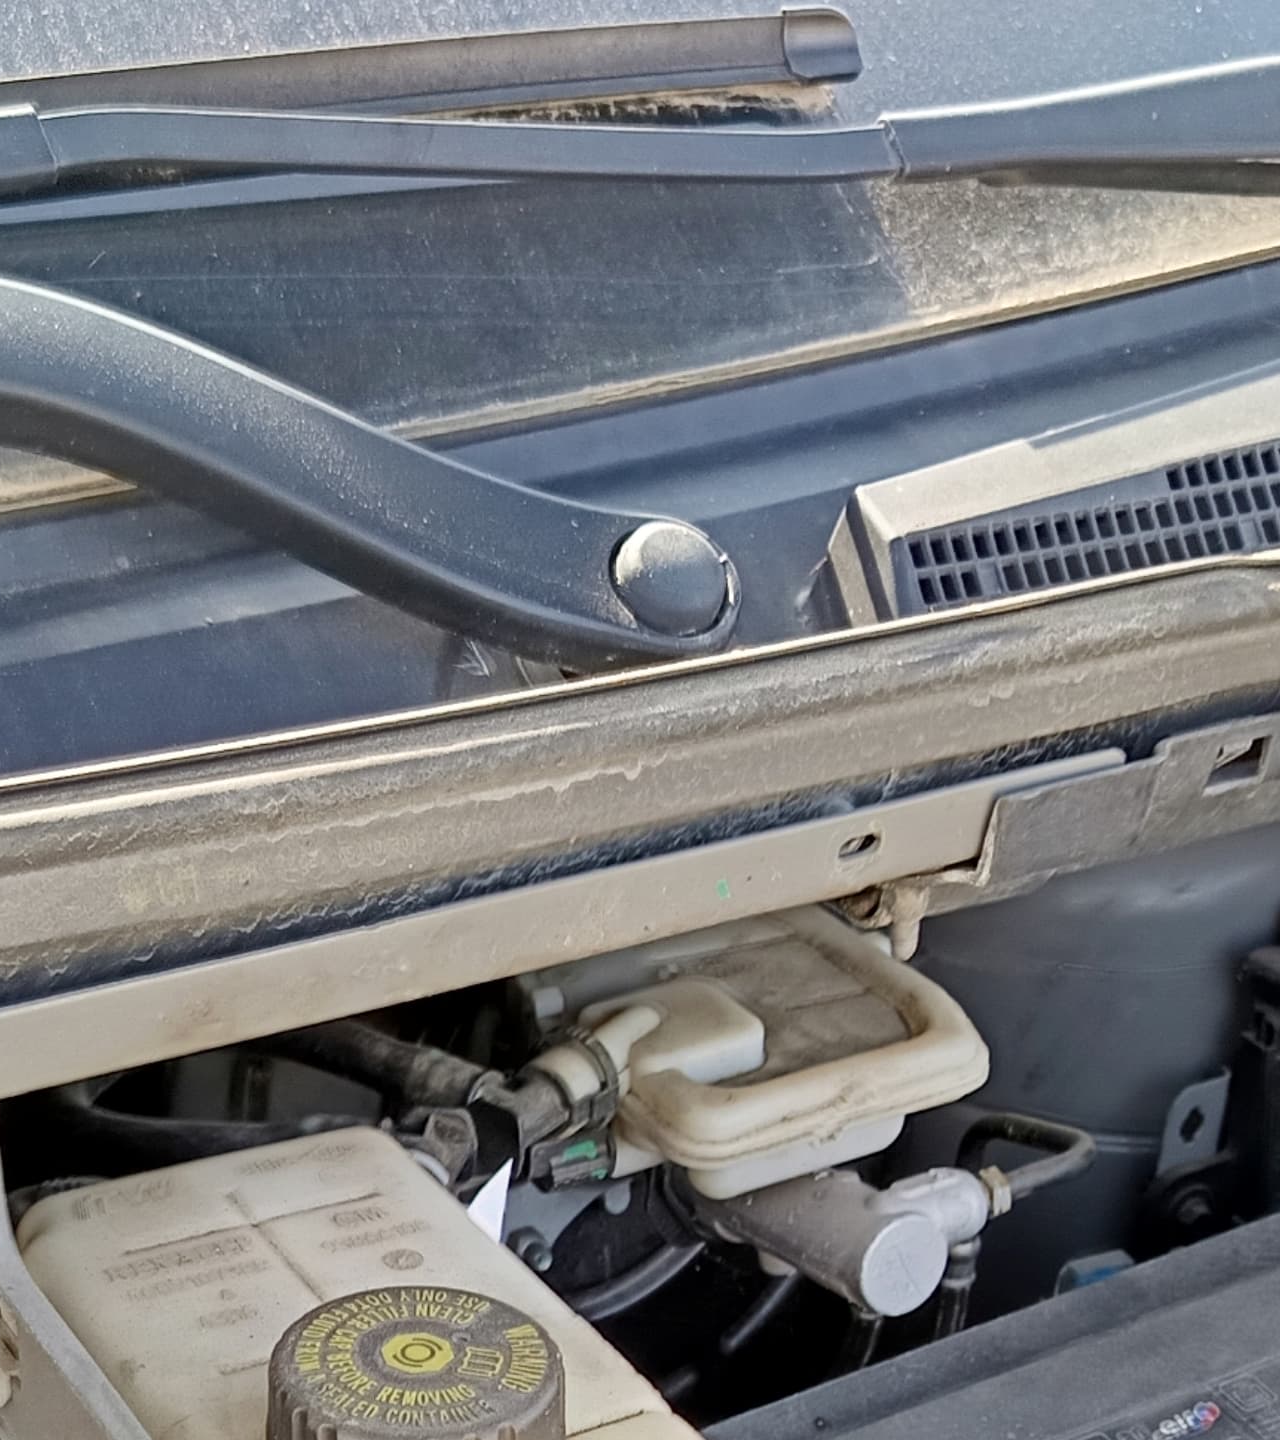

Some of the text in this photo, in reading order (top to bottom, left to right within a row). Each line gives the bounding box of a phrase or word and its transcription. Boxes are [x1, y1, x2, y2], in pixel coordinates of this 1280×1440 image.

[400, 1289, 447, 1303] ONLY
[346, 1304, 410, 1330] FILLER
[415, 1303, 475, 1325] CLEAN
[326, 1353, 379, 1396] BEFORE
[376, 1383, 477, 1407] REMOVING
[386, 1400, 496, 1426] CONTAINER
